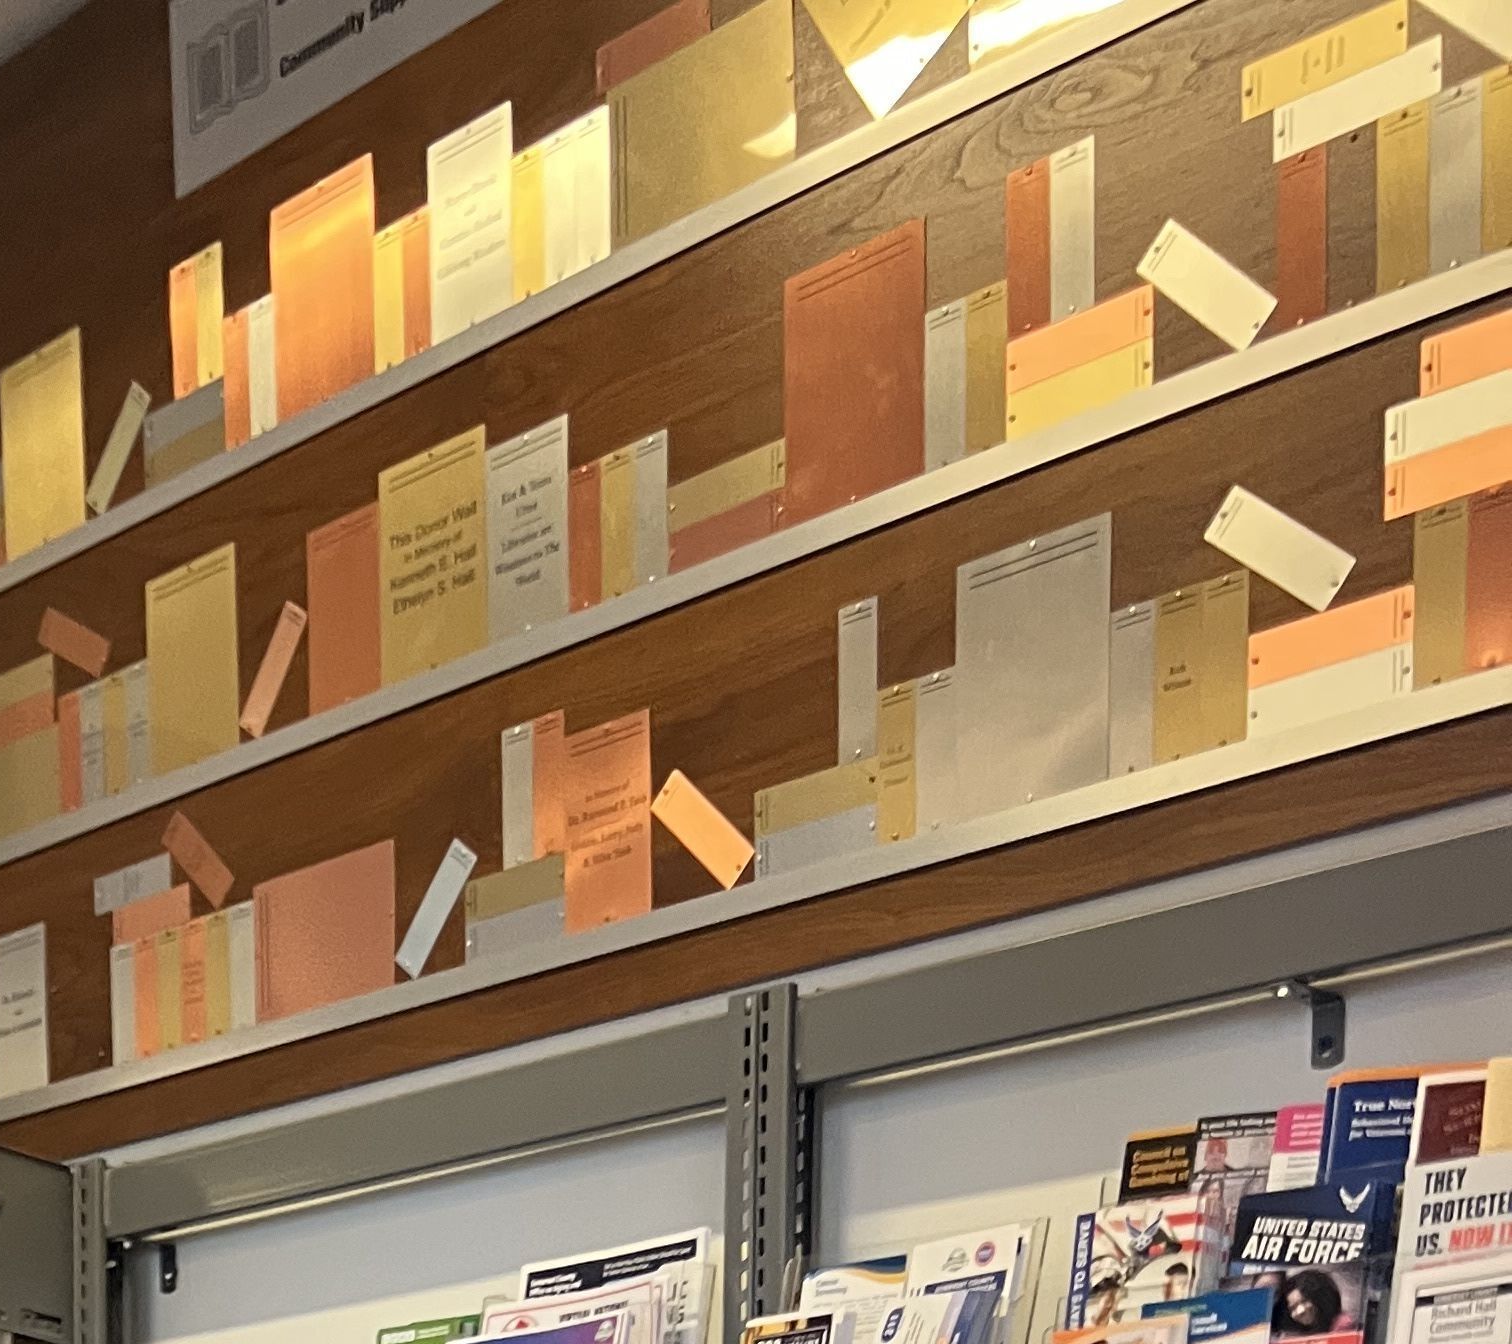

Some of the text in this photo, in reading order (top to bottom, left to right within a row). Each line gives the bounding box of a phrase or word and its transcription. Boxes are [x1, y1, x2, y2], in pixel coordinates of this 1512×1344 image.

[451, 500, 477, 522] Wall
[1353, 1100, 1385, 1112] True
[1424, 1168, 1468, 1196] THEY
[1419, 1190, 1512, 1228] PROTECTE
[1252, 1217, 1366, 1241] UNITED STATES
[1415, 1227, 1495, 1258] US. NOW
[1241, 1237, 1365, 1264] AIR FORCE
